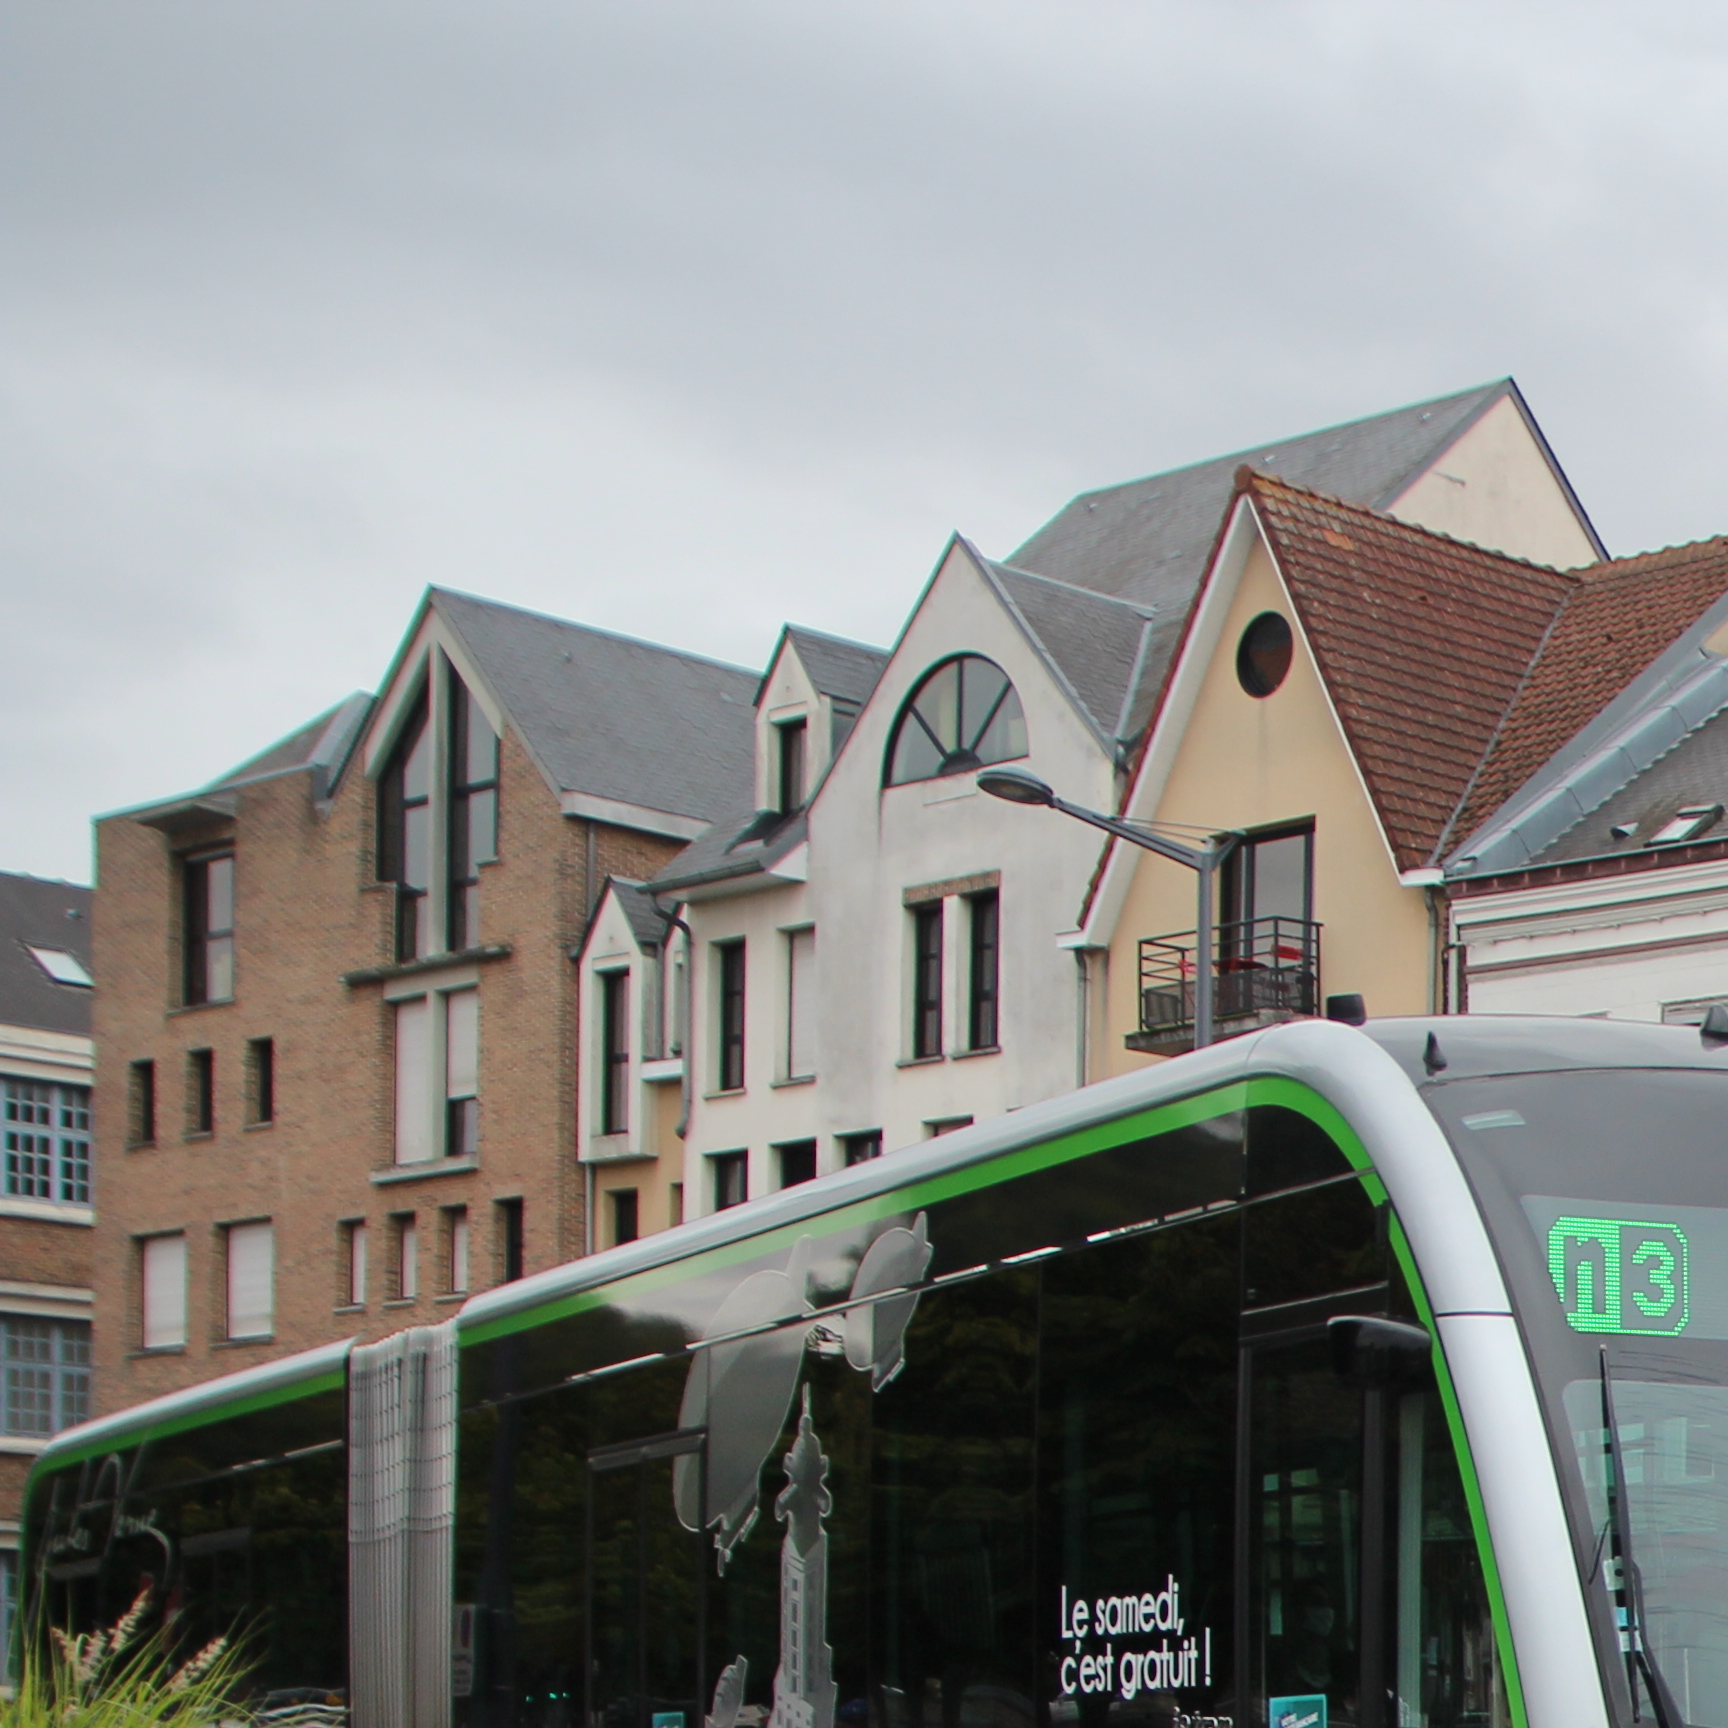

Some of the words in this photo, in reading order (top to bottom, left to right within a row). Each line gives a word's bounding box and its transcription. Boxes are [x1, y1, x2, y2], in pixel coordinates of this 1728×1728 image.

[1061, 1585, 1090, 1638] Le
[1095, 1573, 1185, 1636] samedi,
[1061, 1639, 1114, 1694] c'est
[1120, 1636, 1198, 1700] gratuit
